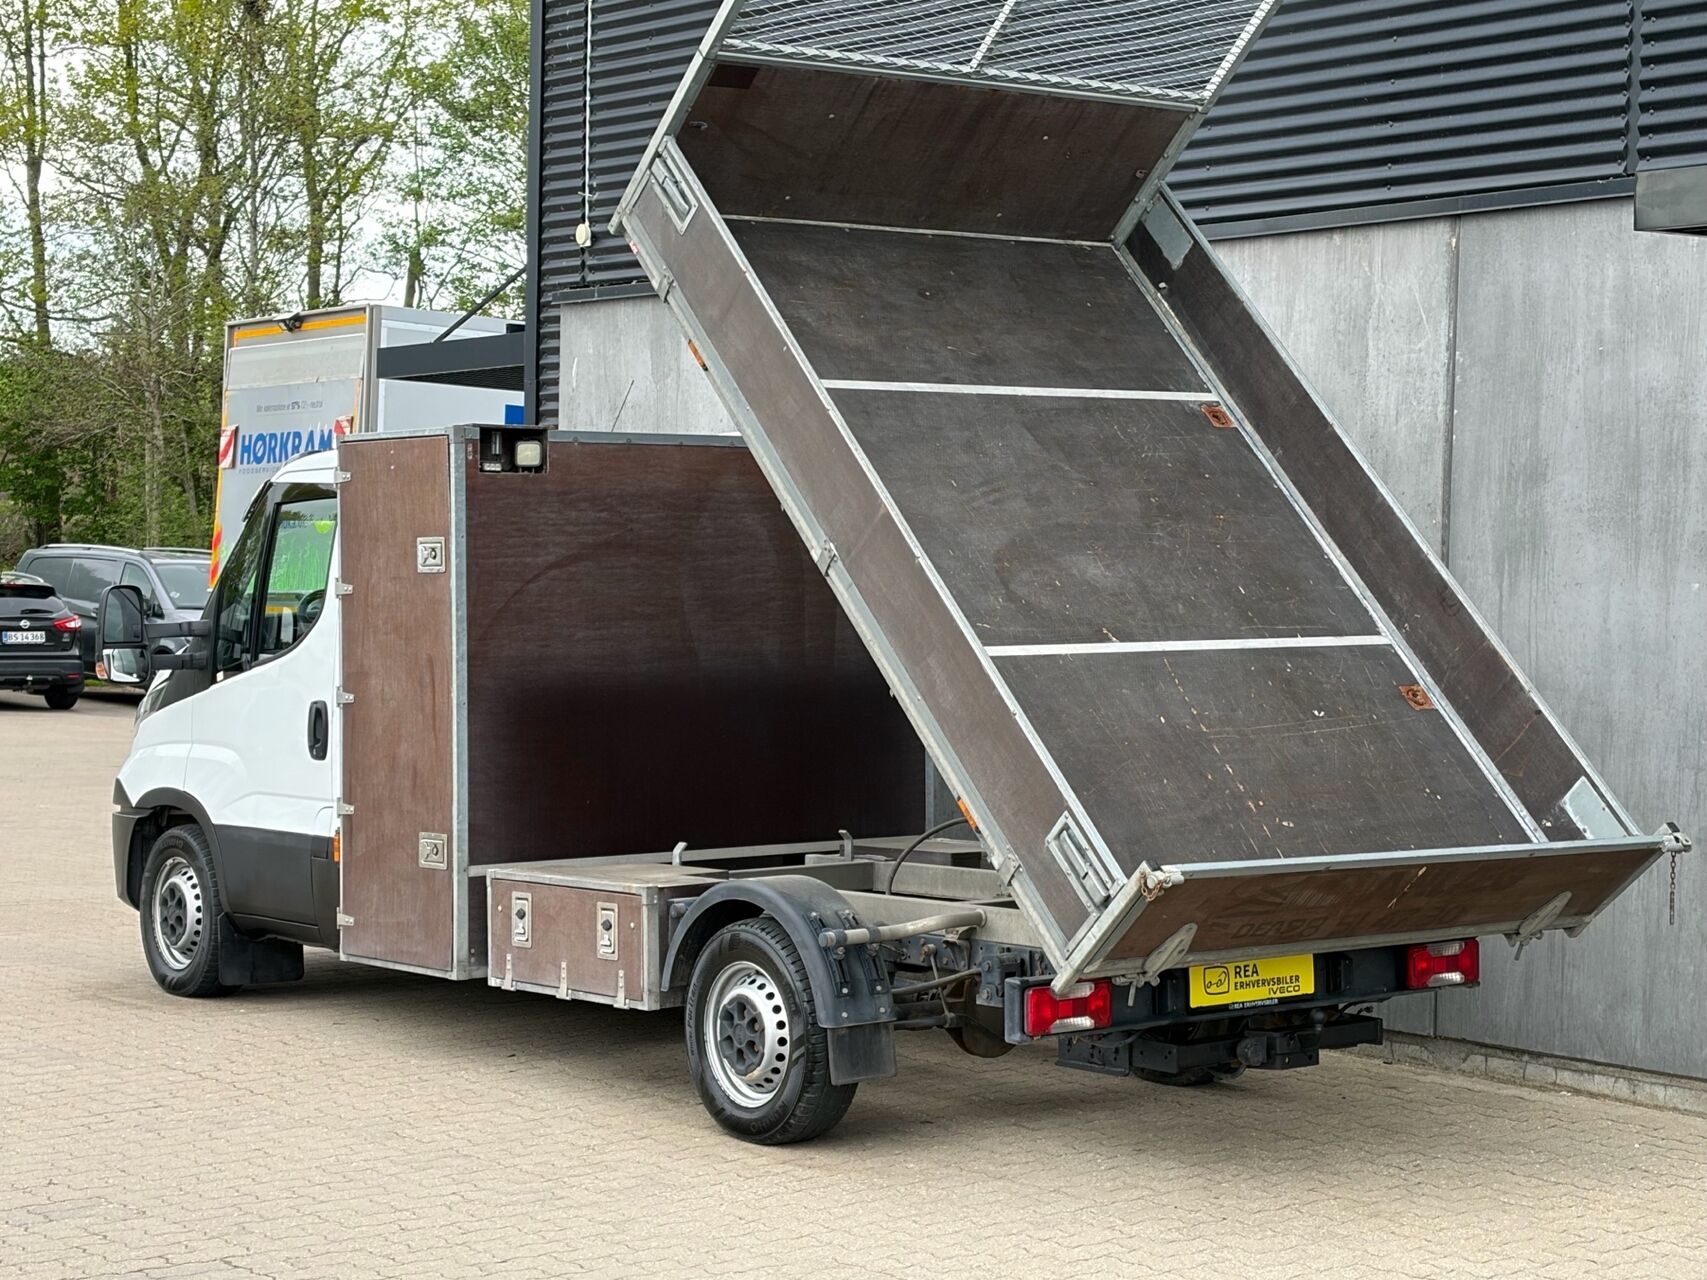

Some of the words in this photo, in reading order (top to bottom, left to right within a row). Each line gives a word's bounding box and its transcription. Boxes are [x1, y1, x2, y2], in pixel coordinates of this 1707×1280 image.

[9, 633, 19, 642] BS
[20, 633, 29, 642] 14
[30, 632, 45, 642] 368
[1234, 963, 1260, 979] REA
[1234, 974, 1300, 991] ERHVERVSBILER
[1268, 984, 1301, 995] IVECO
